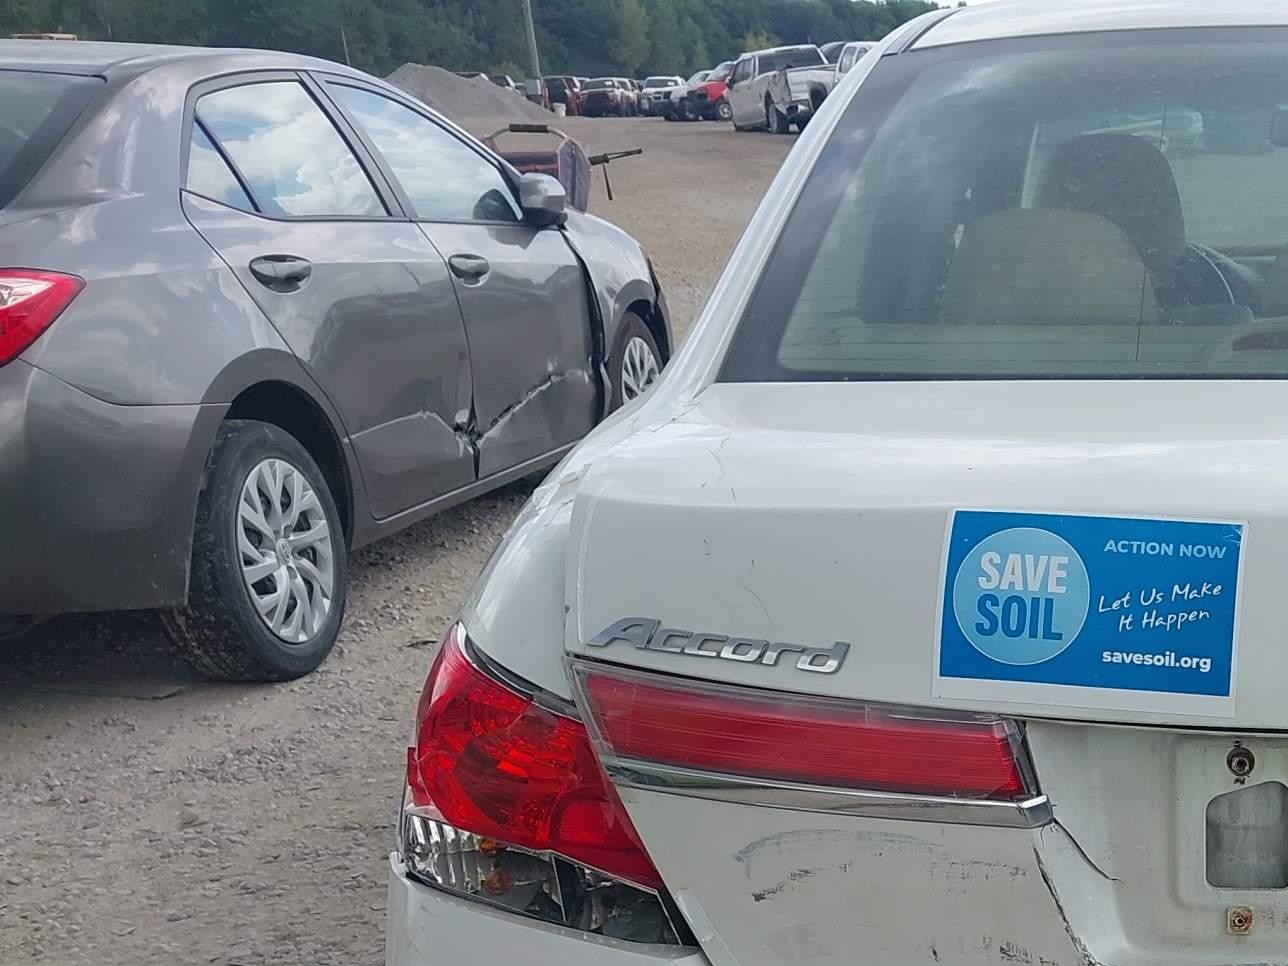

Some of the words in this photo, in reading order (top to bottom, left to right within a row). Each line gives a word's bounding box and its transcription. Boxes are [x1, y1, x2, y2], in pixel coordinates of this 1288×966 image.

[1103, 539, 1174, 557] ACTION
[1178, 543, 1227, 559] NOW
[977, 551, 1069, 594] SAVE
[1098, 592, 1132, 613] Let
[1140, 588, 1165, 606] Us
[1171, 582, 1223, 602] Make
[975, 593, 1064, 642] SOIL
[1118, 613, 1133, 632] It
[1141, 609, 1210, 632] Happen
[587, 617, 851, 674] Accord
[1102, 651, 1212, 673] savesoil.org
